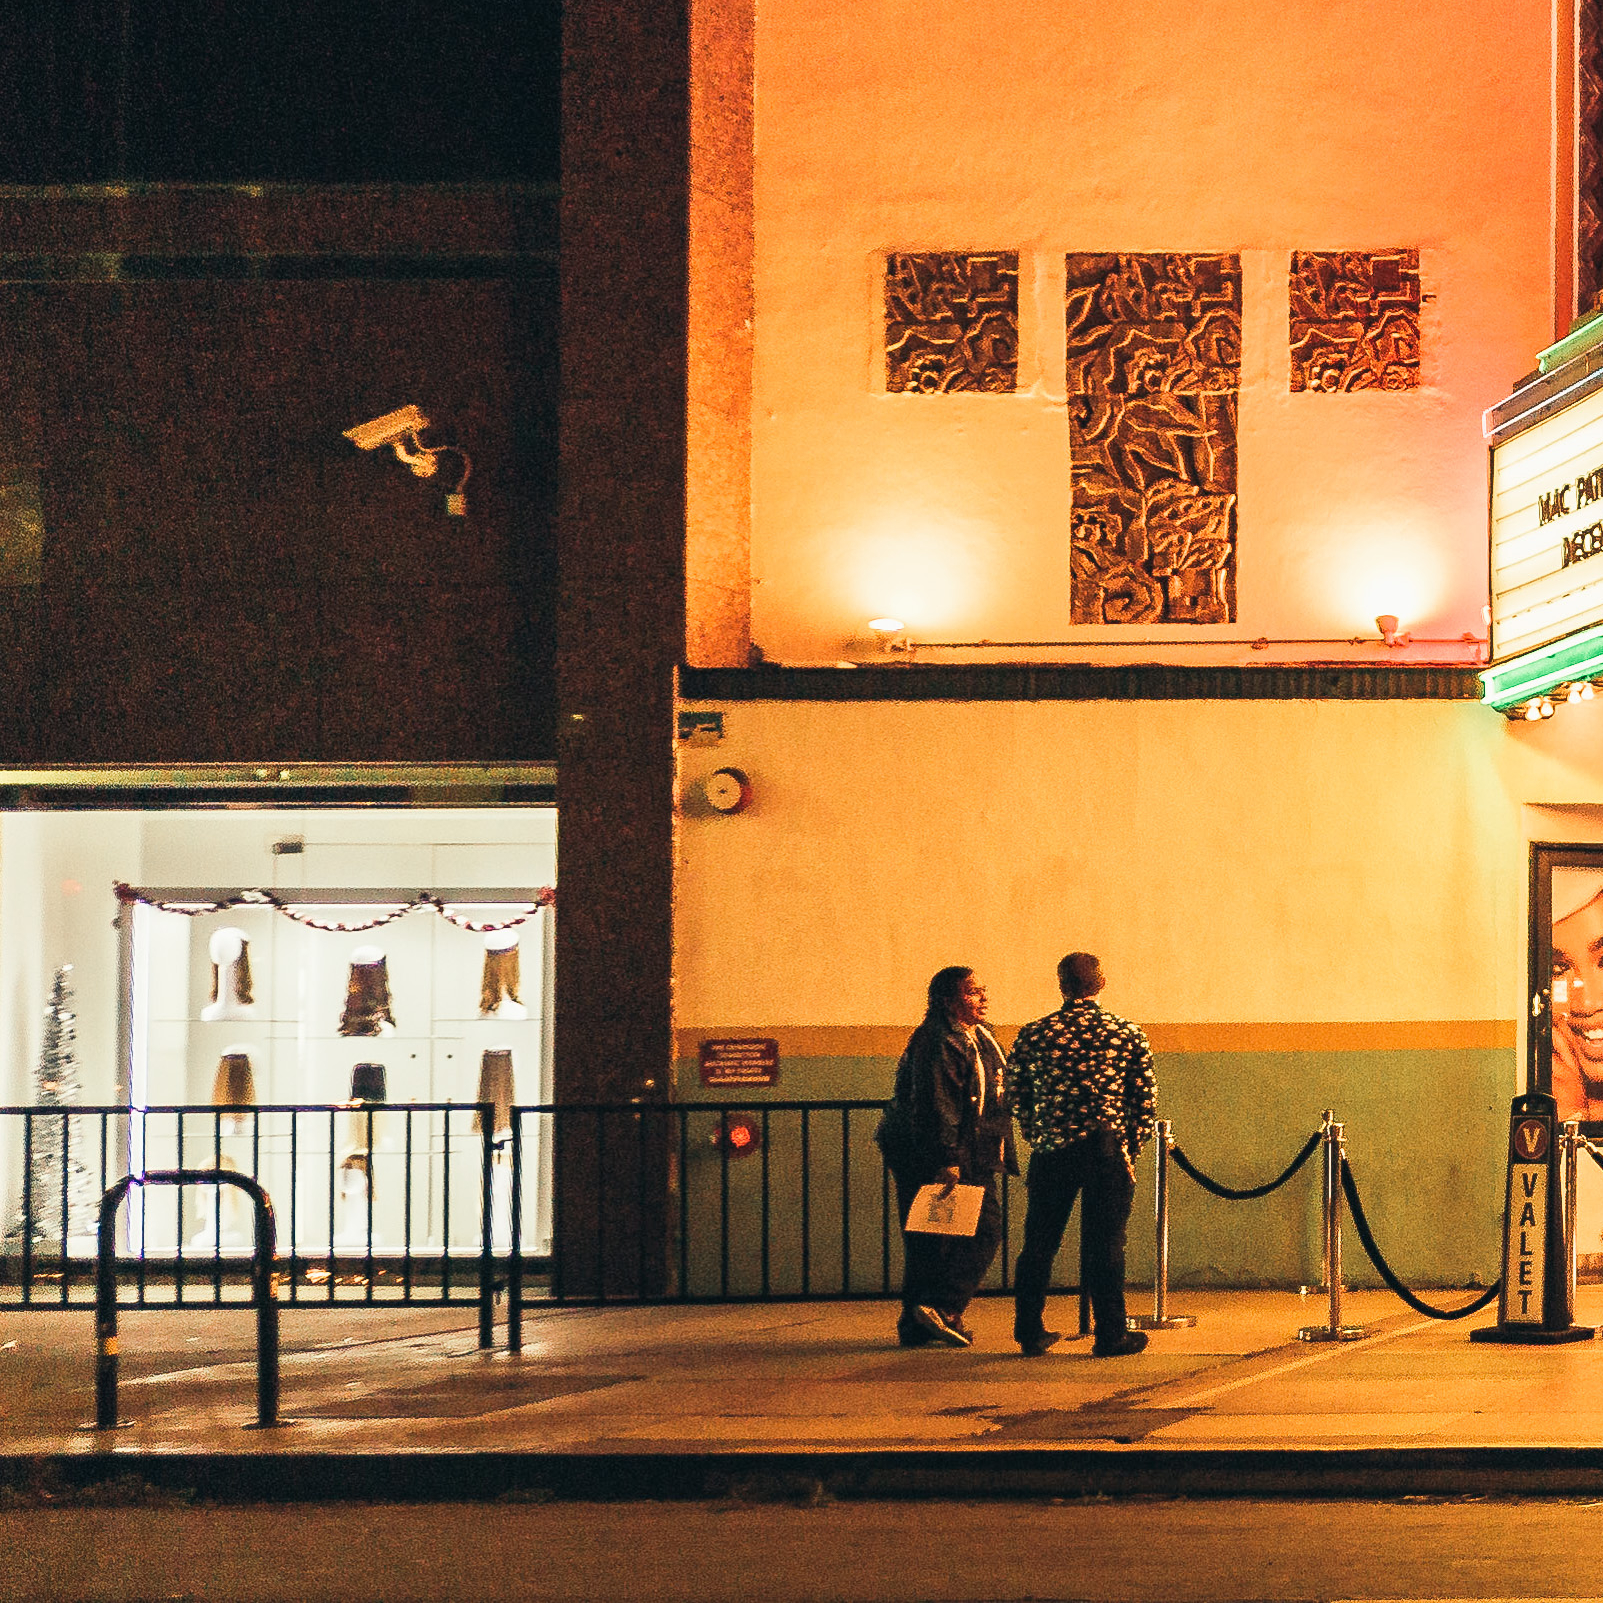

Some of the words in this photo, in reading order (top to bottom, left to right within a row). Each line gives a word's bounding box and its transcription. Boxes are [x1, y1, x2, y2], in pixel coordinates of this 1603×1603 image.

[1538, 483, 1571, 527] MAC
[1522, 1127, 1540, 1154] V
[1519, 1172, 1537, 1315] VALET
